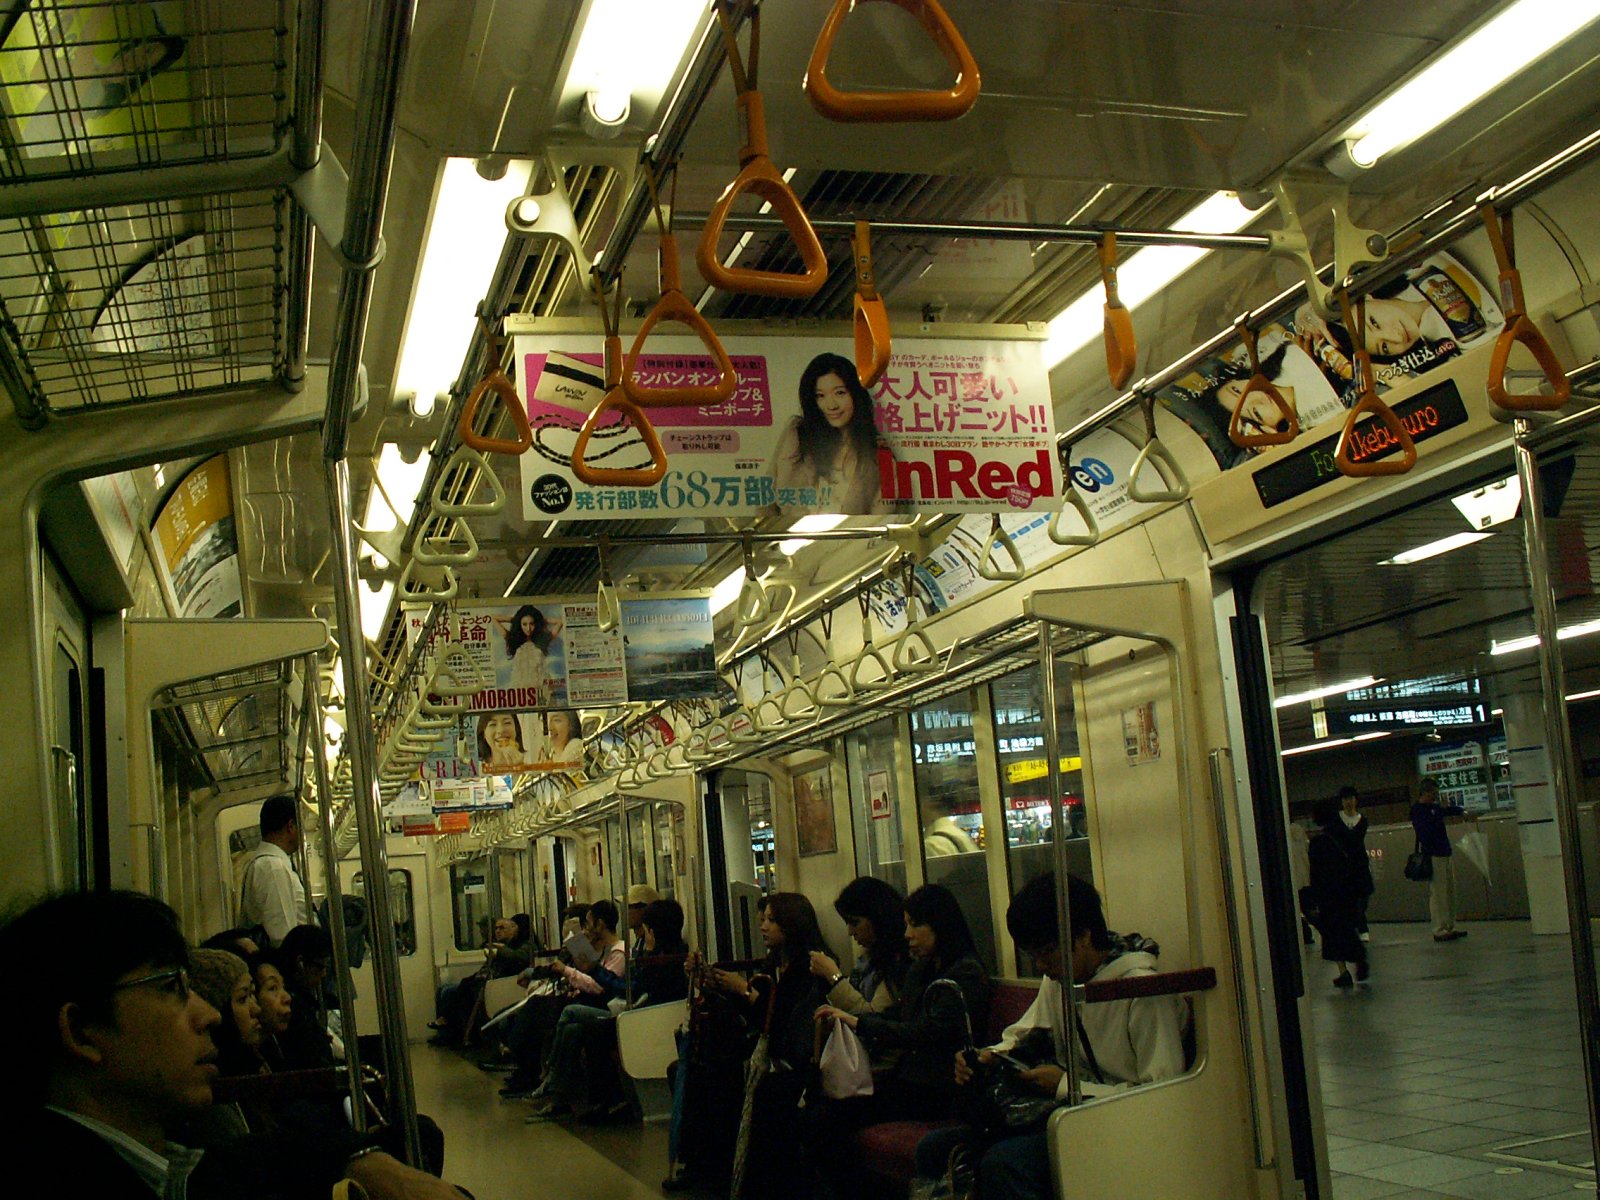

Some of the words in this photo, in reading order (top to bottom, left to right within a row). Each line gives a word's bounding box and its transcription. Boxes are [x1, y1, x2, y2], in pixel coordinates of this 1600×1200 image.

[873, 370, 1018, 402] 大人可愛い
[1348, 405, 1440, 461] Ikebuuro
[878, 449, 1054, 499] InRed
[1476, 704, 1485, 722] 1
